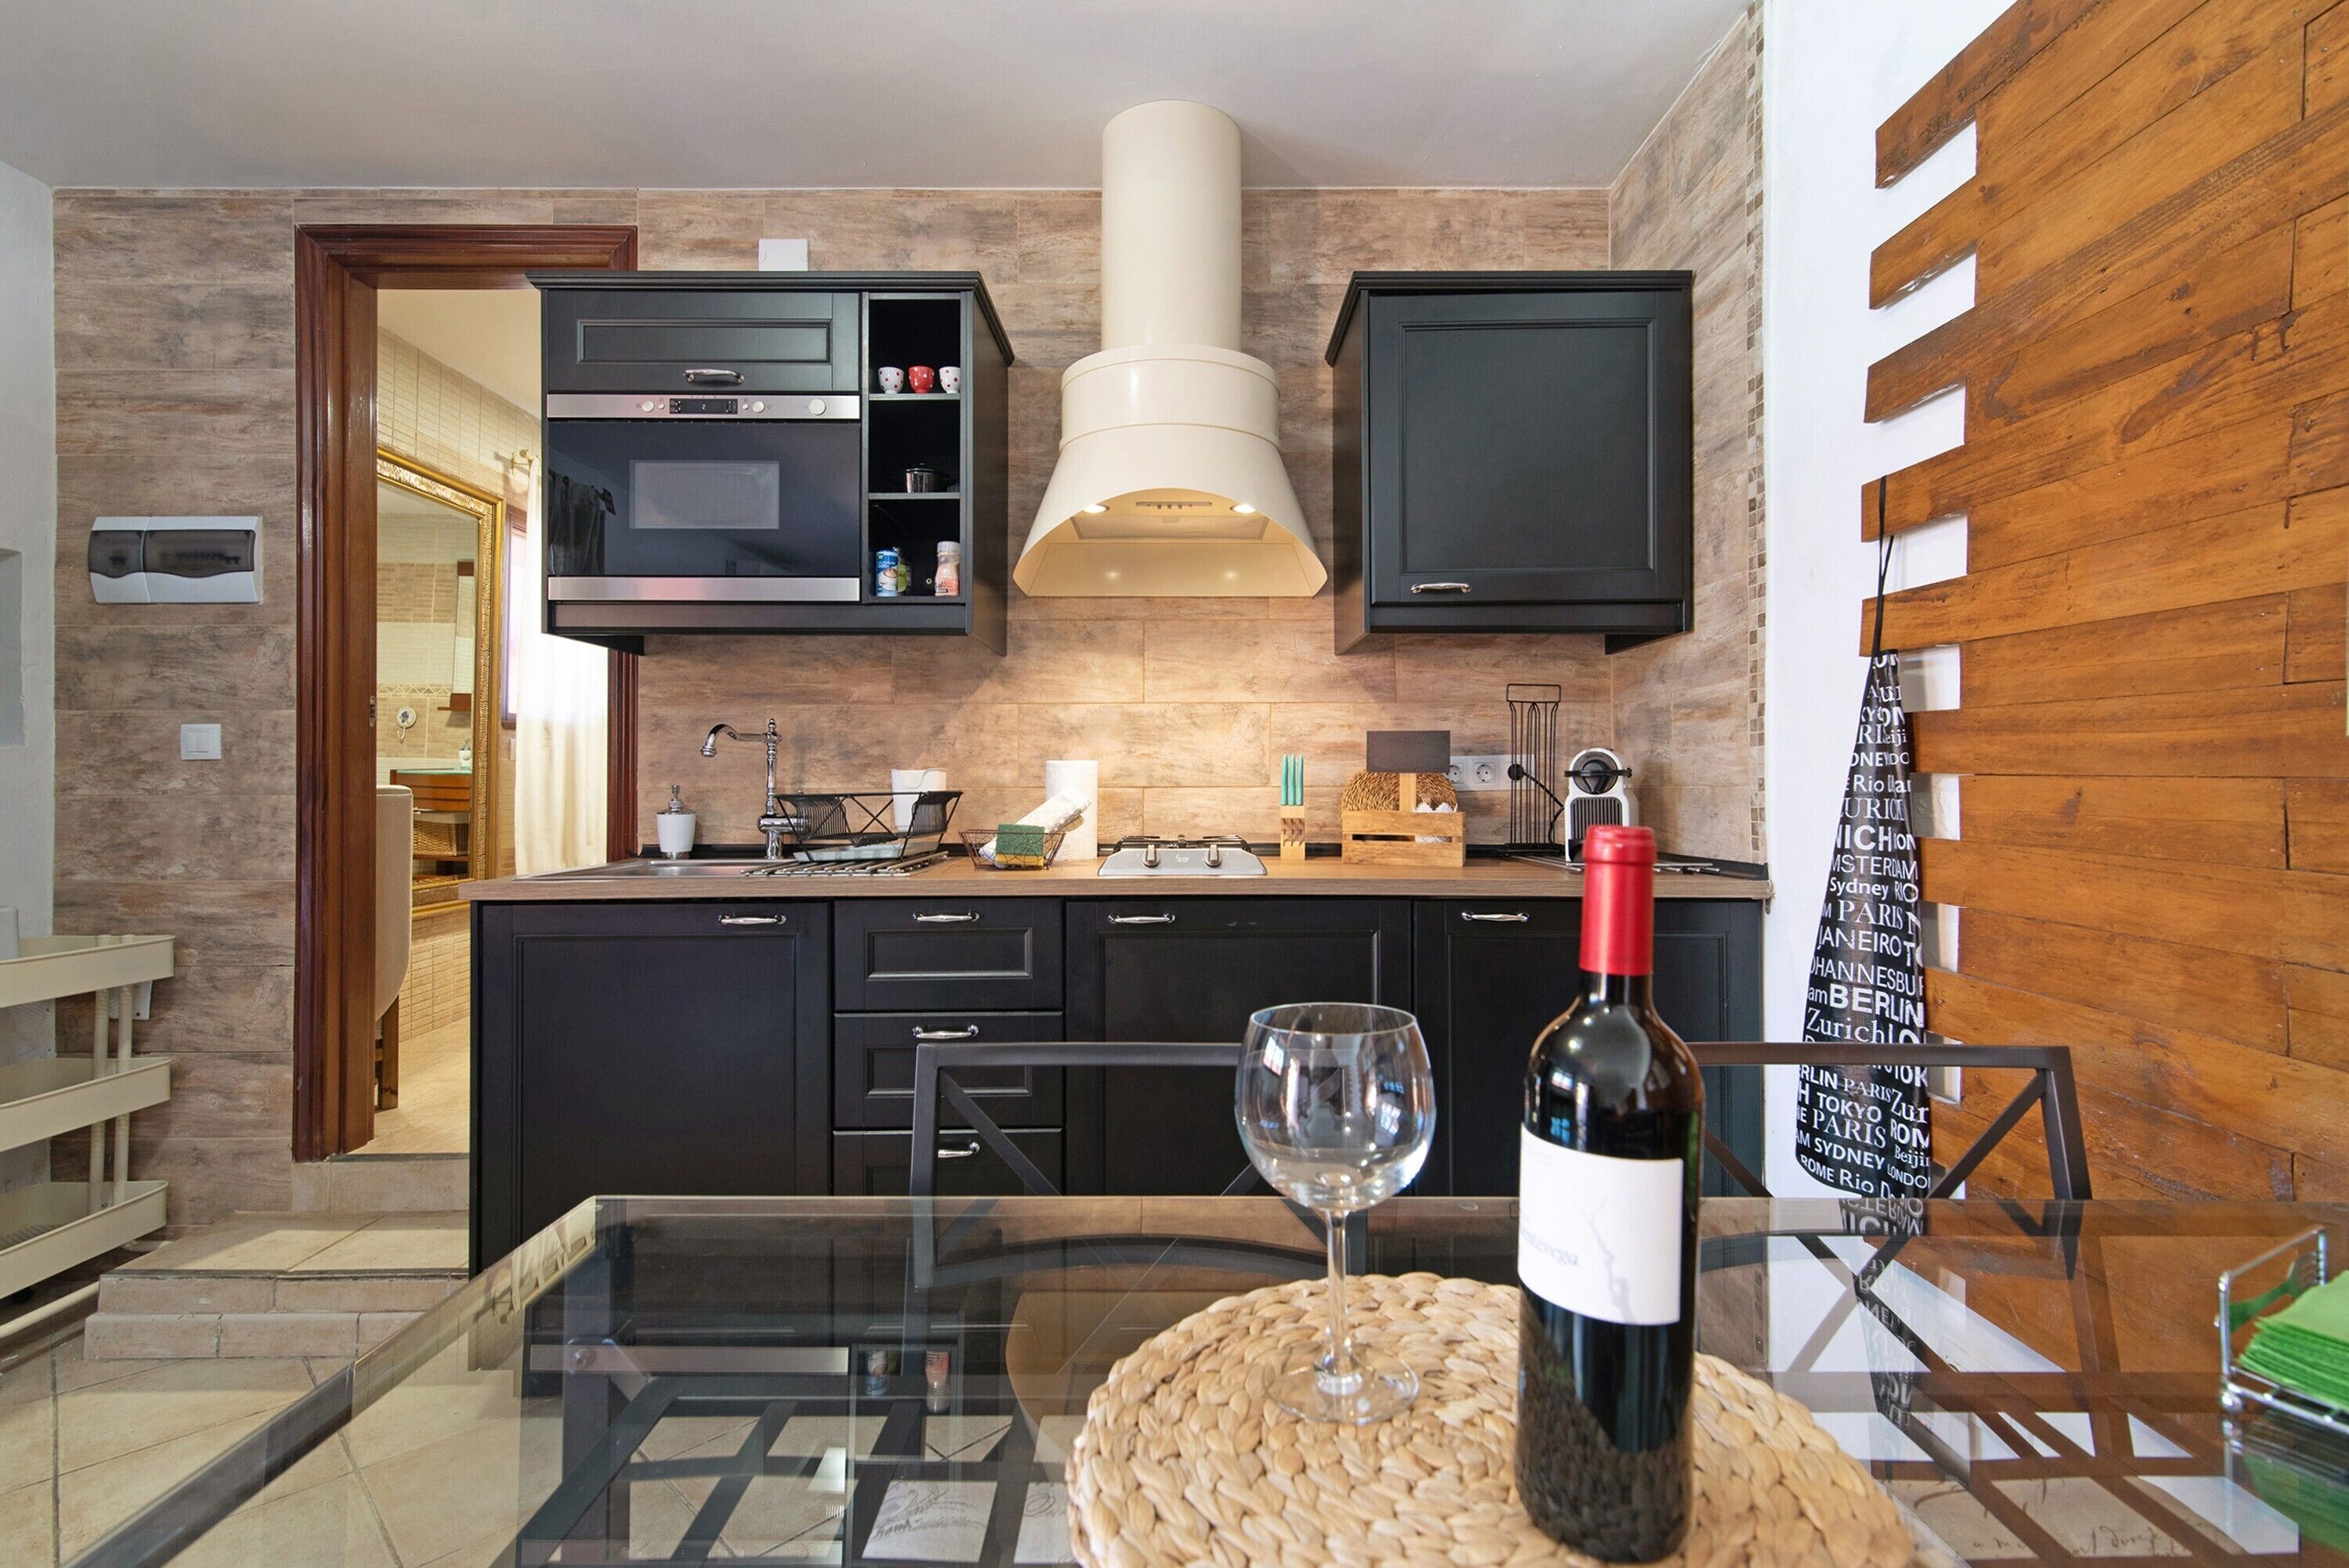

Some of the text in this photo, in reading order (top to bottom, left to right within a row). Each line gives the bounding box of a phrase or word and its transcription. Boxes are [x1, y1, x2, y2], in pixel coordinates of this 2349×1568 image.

[1853, 774, 1884, 792] Rio
[1830, 877, 1889, 900] Sydney
[1837, 899, 1903, 930] PARIS
[1817, 925, 1902, 957] JANEIRO
[1830, 983, 1924, 1028] BERLIN
[1806, 1007, 1885, 1044] Zurich
[1843, 1077, 1891, 1102] PARIS
[1817, 1092, 1882, 1123] TOKYO
[1812, 1108, 1886, 1148] PARIS
[1815, 1137, 1885, 1170] SYDNEY
[1800, 1154, 1835, 1183] ROME
[1839, 1168, 1874, 1193] Rio
